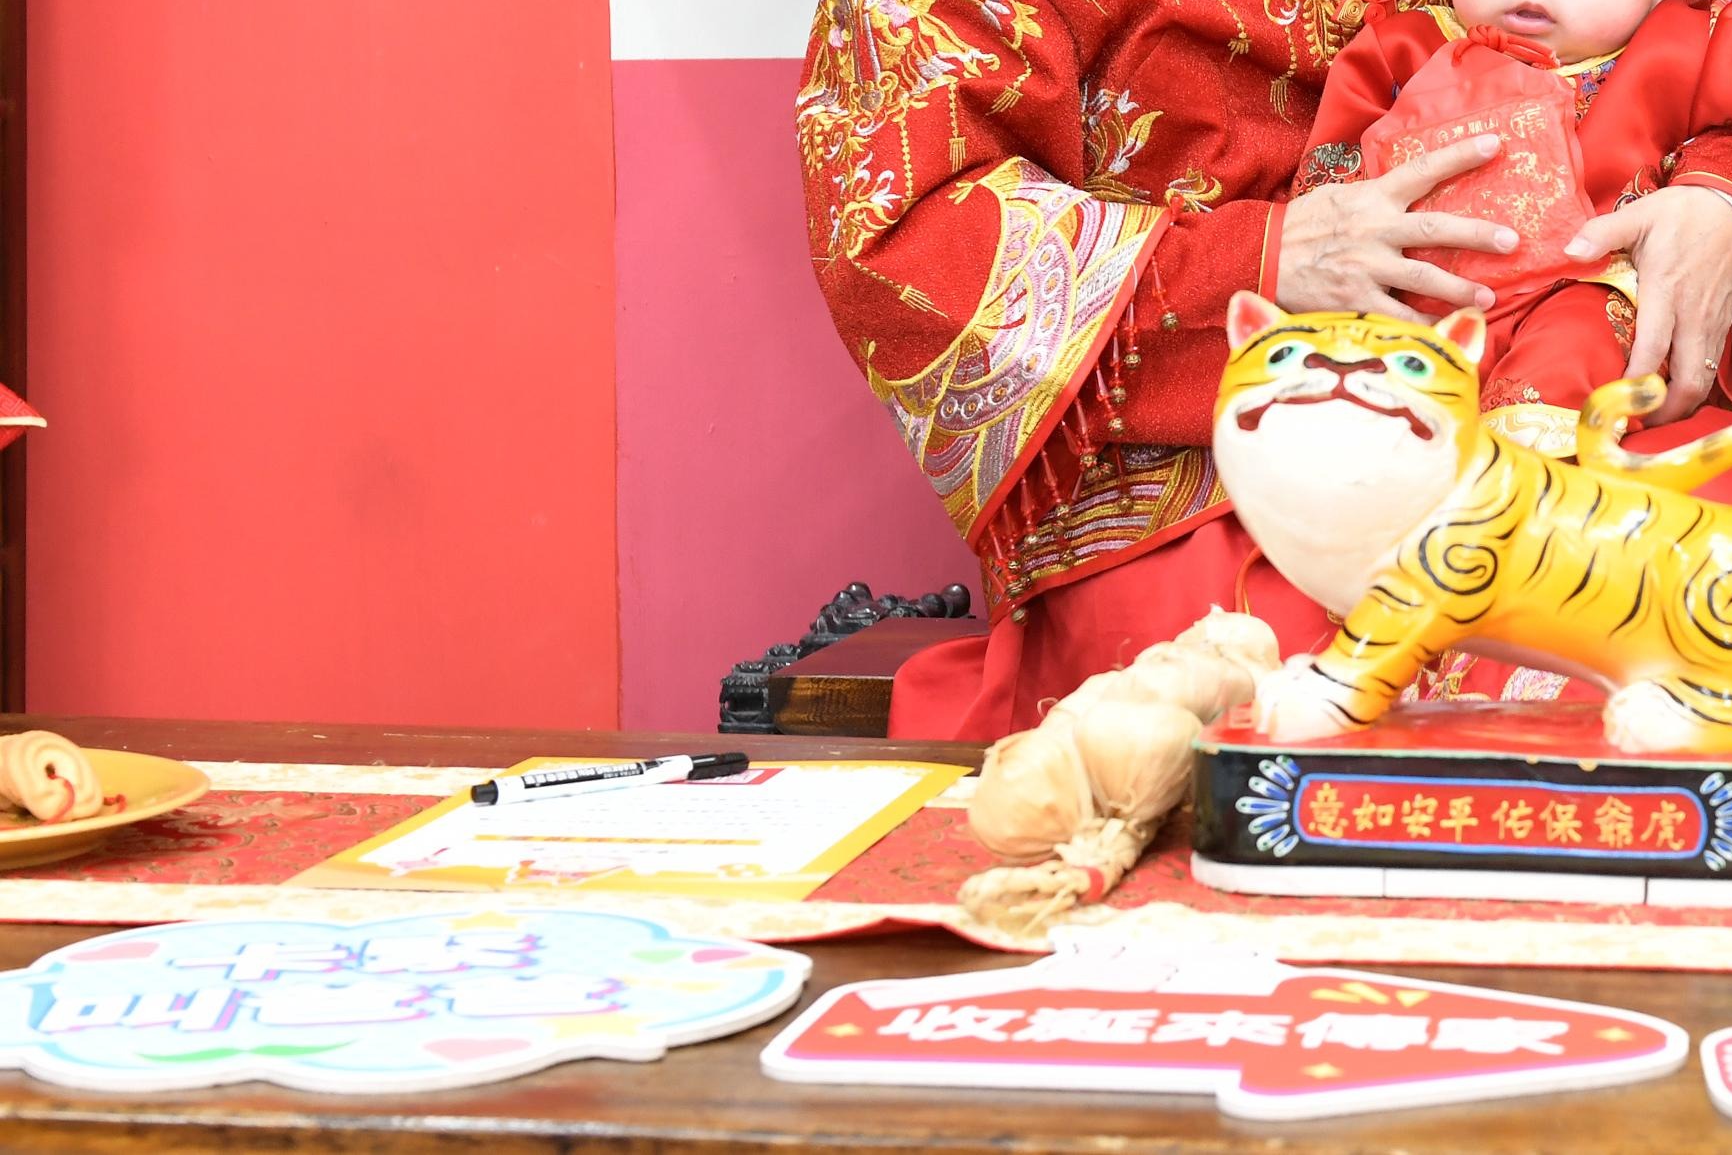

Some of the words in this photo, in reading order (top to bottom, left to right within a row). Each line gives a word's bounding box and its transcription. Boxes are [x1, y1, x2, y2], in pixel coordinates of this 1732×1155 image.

[877, 1004, 1570, 1055] 收涎來傳家
